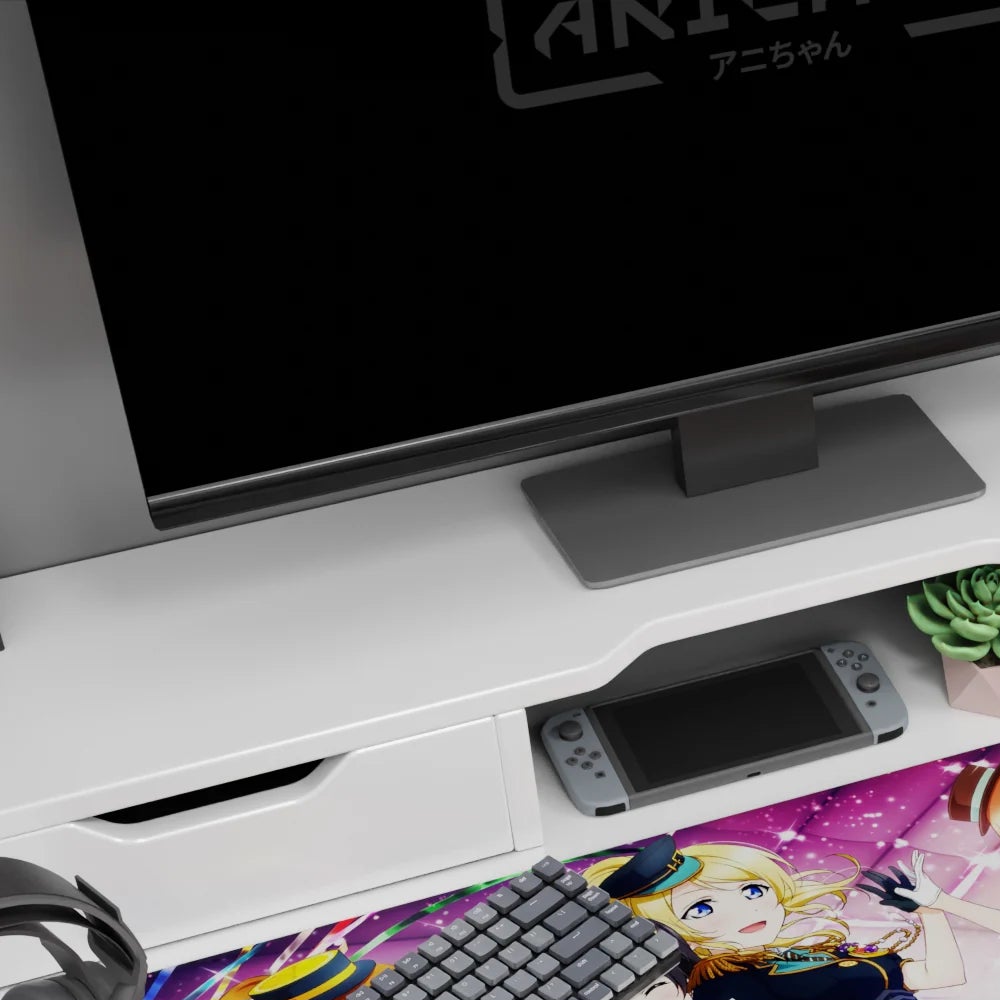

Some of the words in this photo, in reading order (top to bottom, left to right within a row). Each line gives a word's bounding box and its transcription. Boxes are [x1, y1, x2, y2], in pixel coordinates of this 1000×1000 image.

[709, 30, 852, 81] アニちゃん
